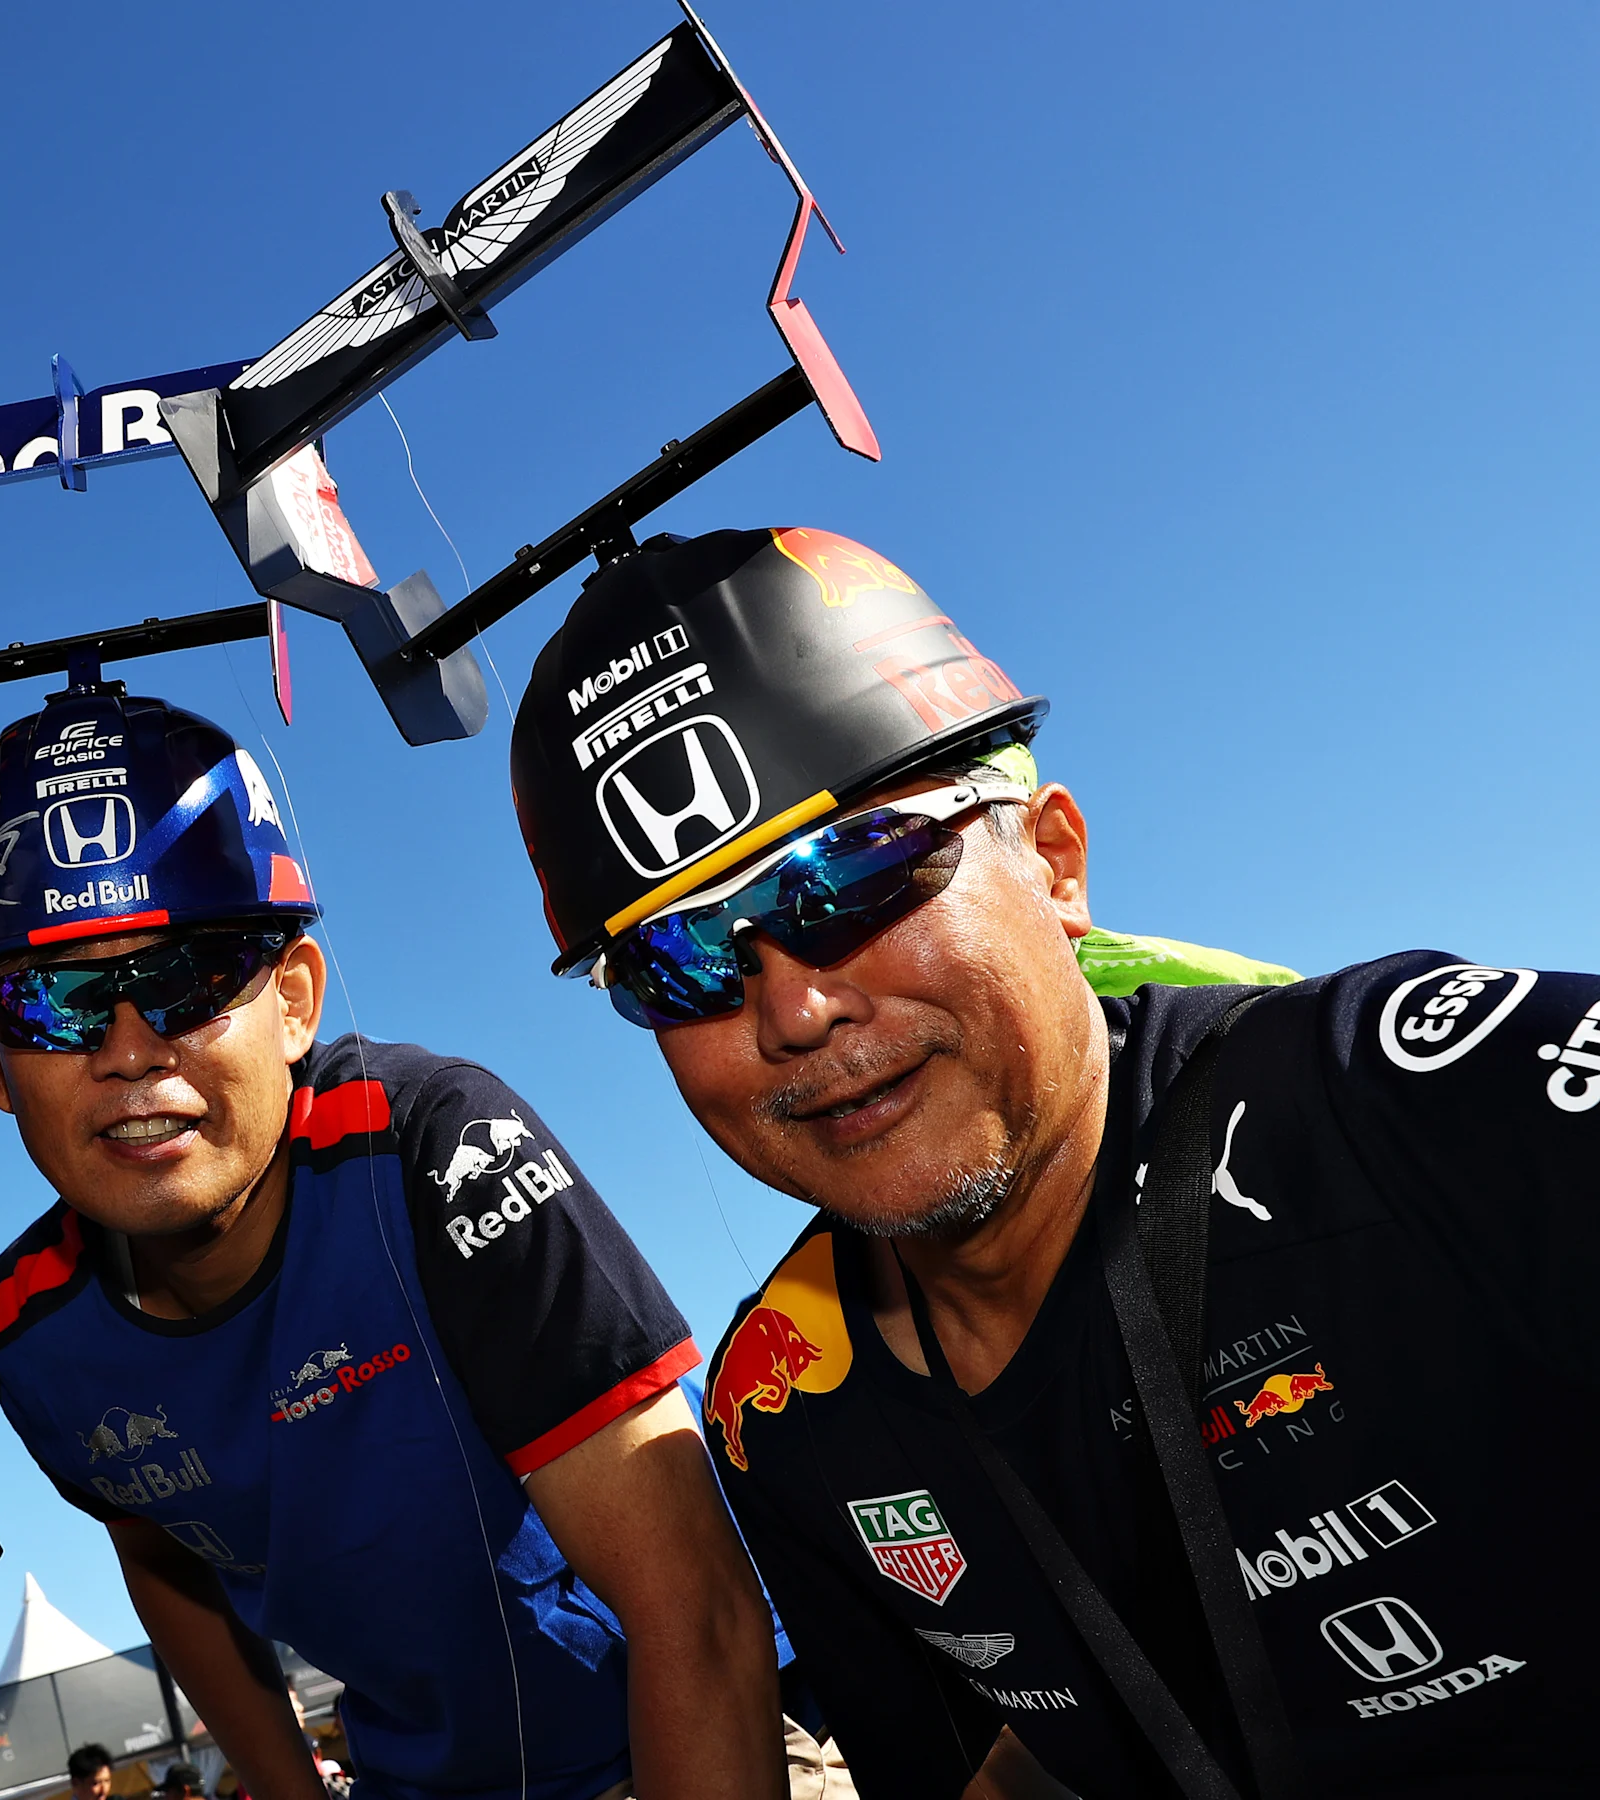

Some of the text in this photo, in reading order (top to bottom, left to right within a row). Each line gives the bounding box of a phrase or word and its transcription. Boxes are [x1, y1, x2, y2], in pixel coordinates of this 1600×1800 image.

[444, 160, 541, 246] MARTIN
[567, 640, 653, 716] Mobil
[572, 662, 714, 771] PIRELLI
[35, 734, 123, 760] EDIFICE
[53, 750, 106, 767] CASIO
[37, 767, 127, 799] PIRELLI
[44, 874, 150, 914] Red Bull
[445, 1148, 575, 1259] Red Bull
[1203, 1314, 1308, 1384] MARTIN
[273, 1343, 411, 1424] Toro Rosso
[90, 1448, 212, 1506] Red Bull
[860, 1499, 940, 1539] TAG
[876, 1544, 961, 1596] HEUER
[993, 1687, 1079, 1710] MARTIN
[1346, 1654, 1527, 1719] HONDA
